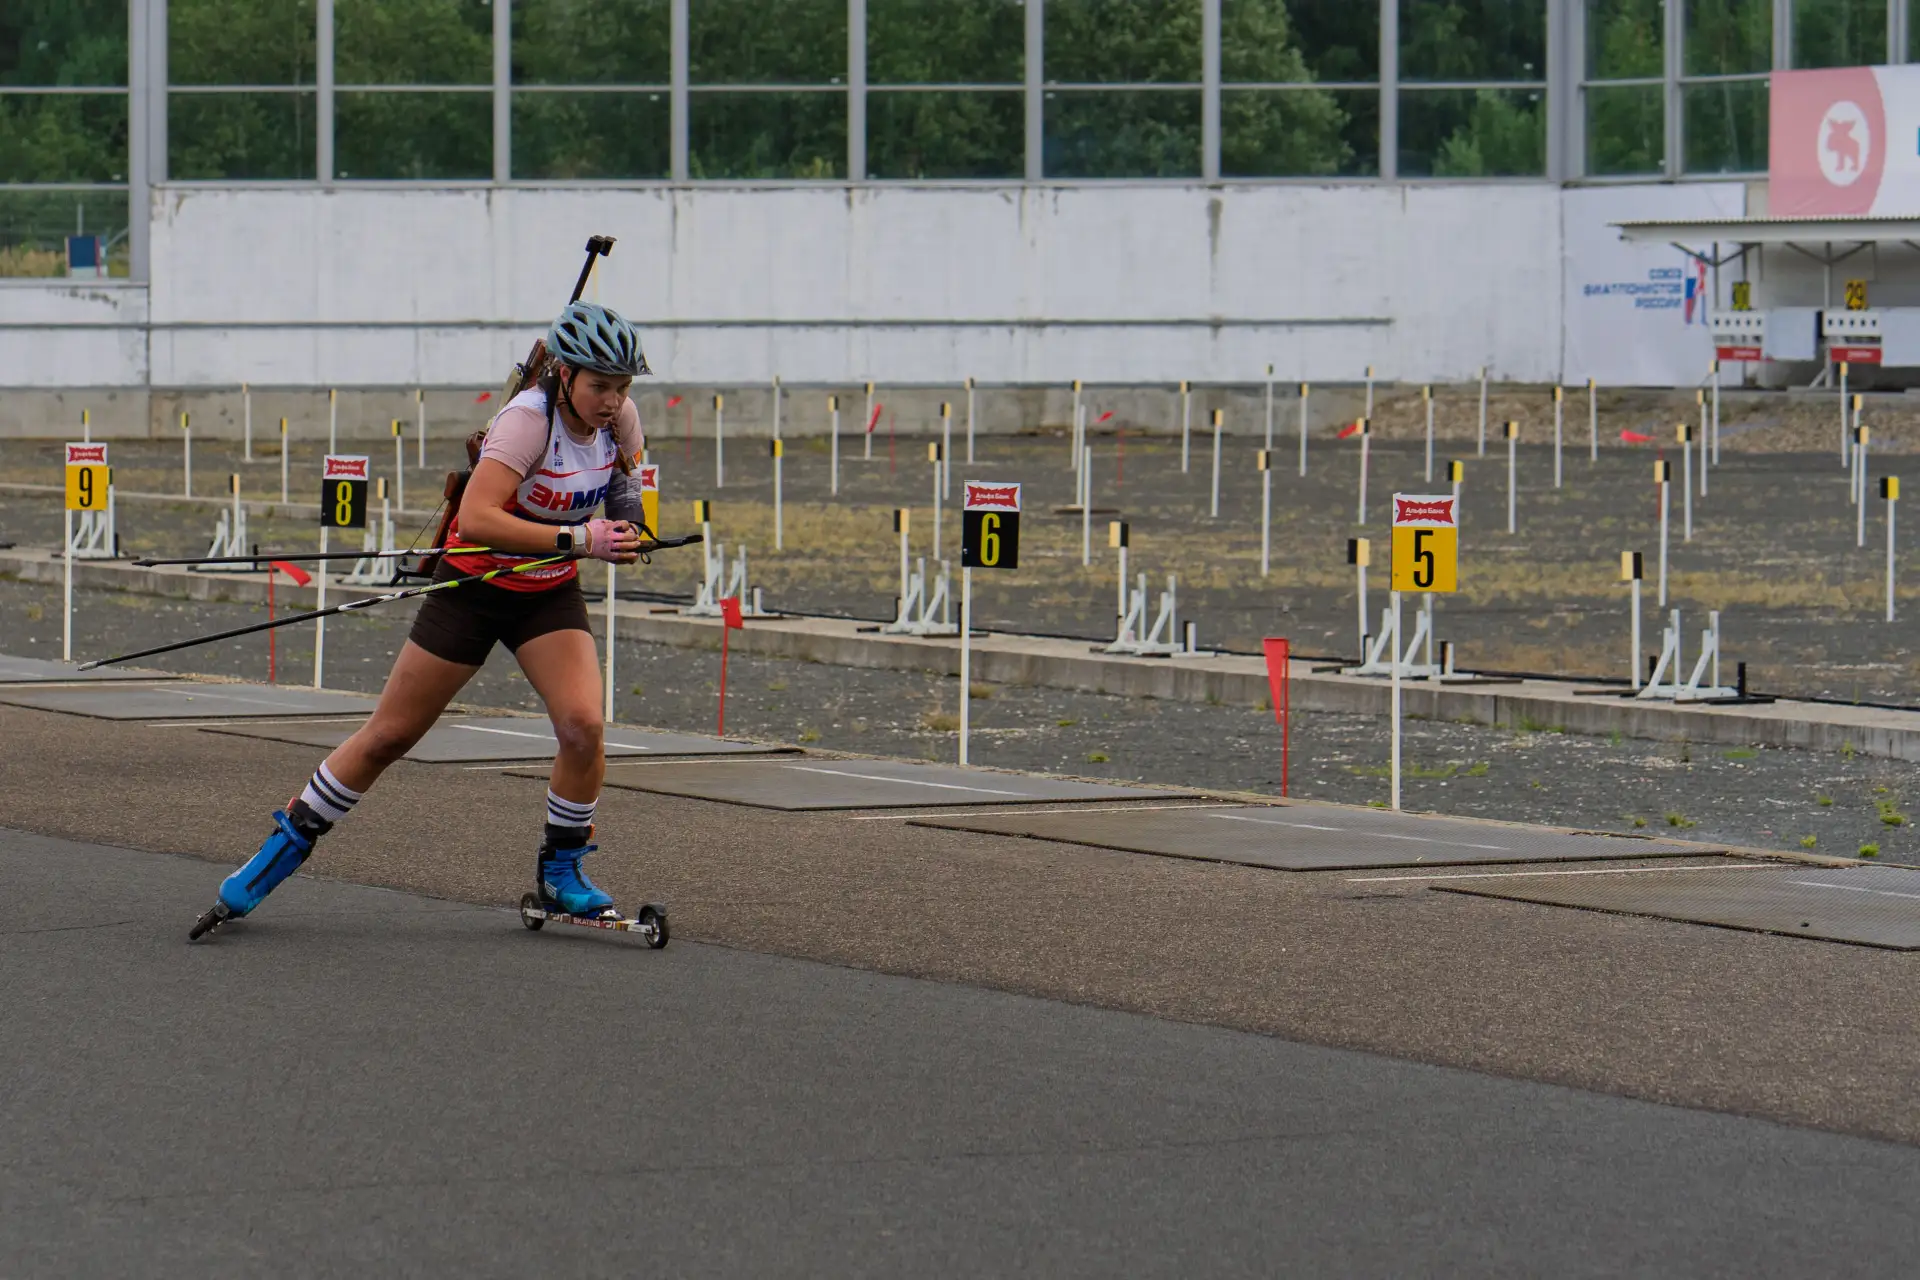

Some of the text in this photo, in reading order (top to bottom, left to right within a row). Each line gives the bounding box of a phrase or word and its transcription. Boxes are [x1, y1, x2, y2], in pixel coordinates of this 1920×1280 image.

[79, 467, 92, 508] 9
[335, 481, 352, 526] 8
[980, 512, 1001, 566] 6
[1413, 529, 1434, 588] 5
